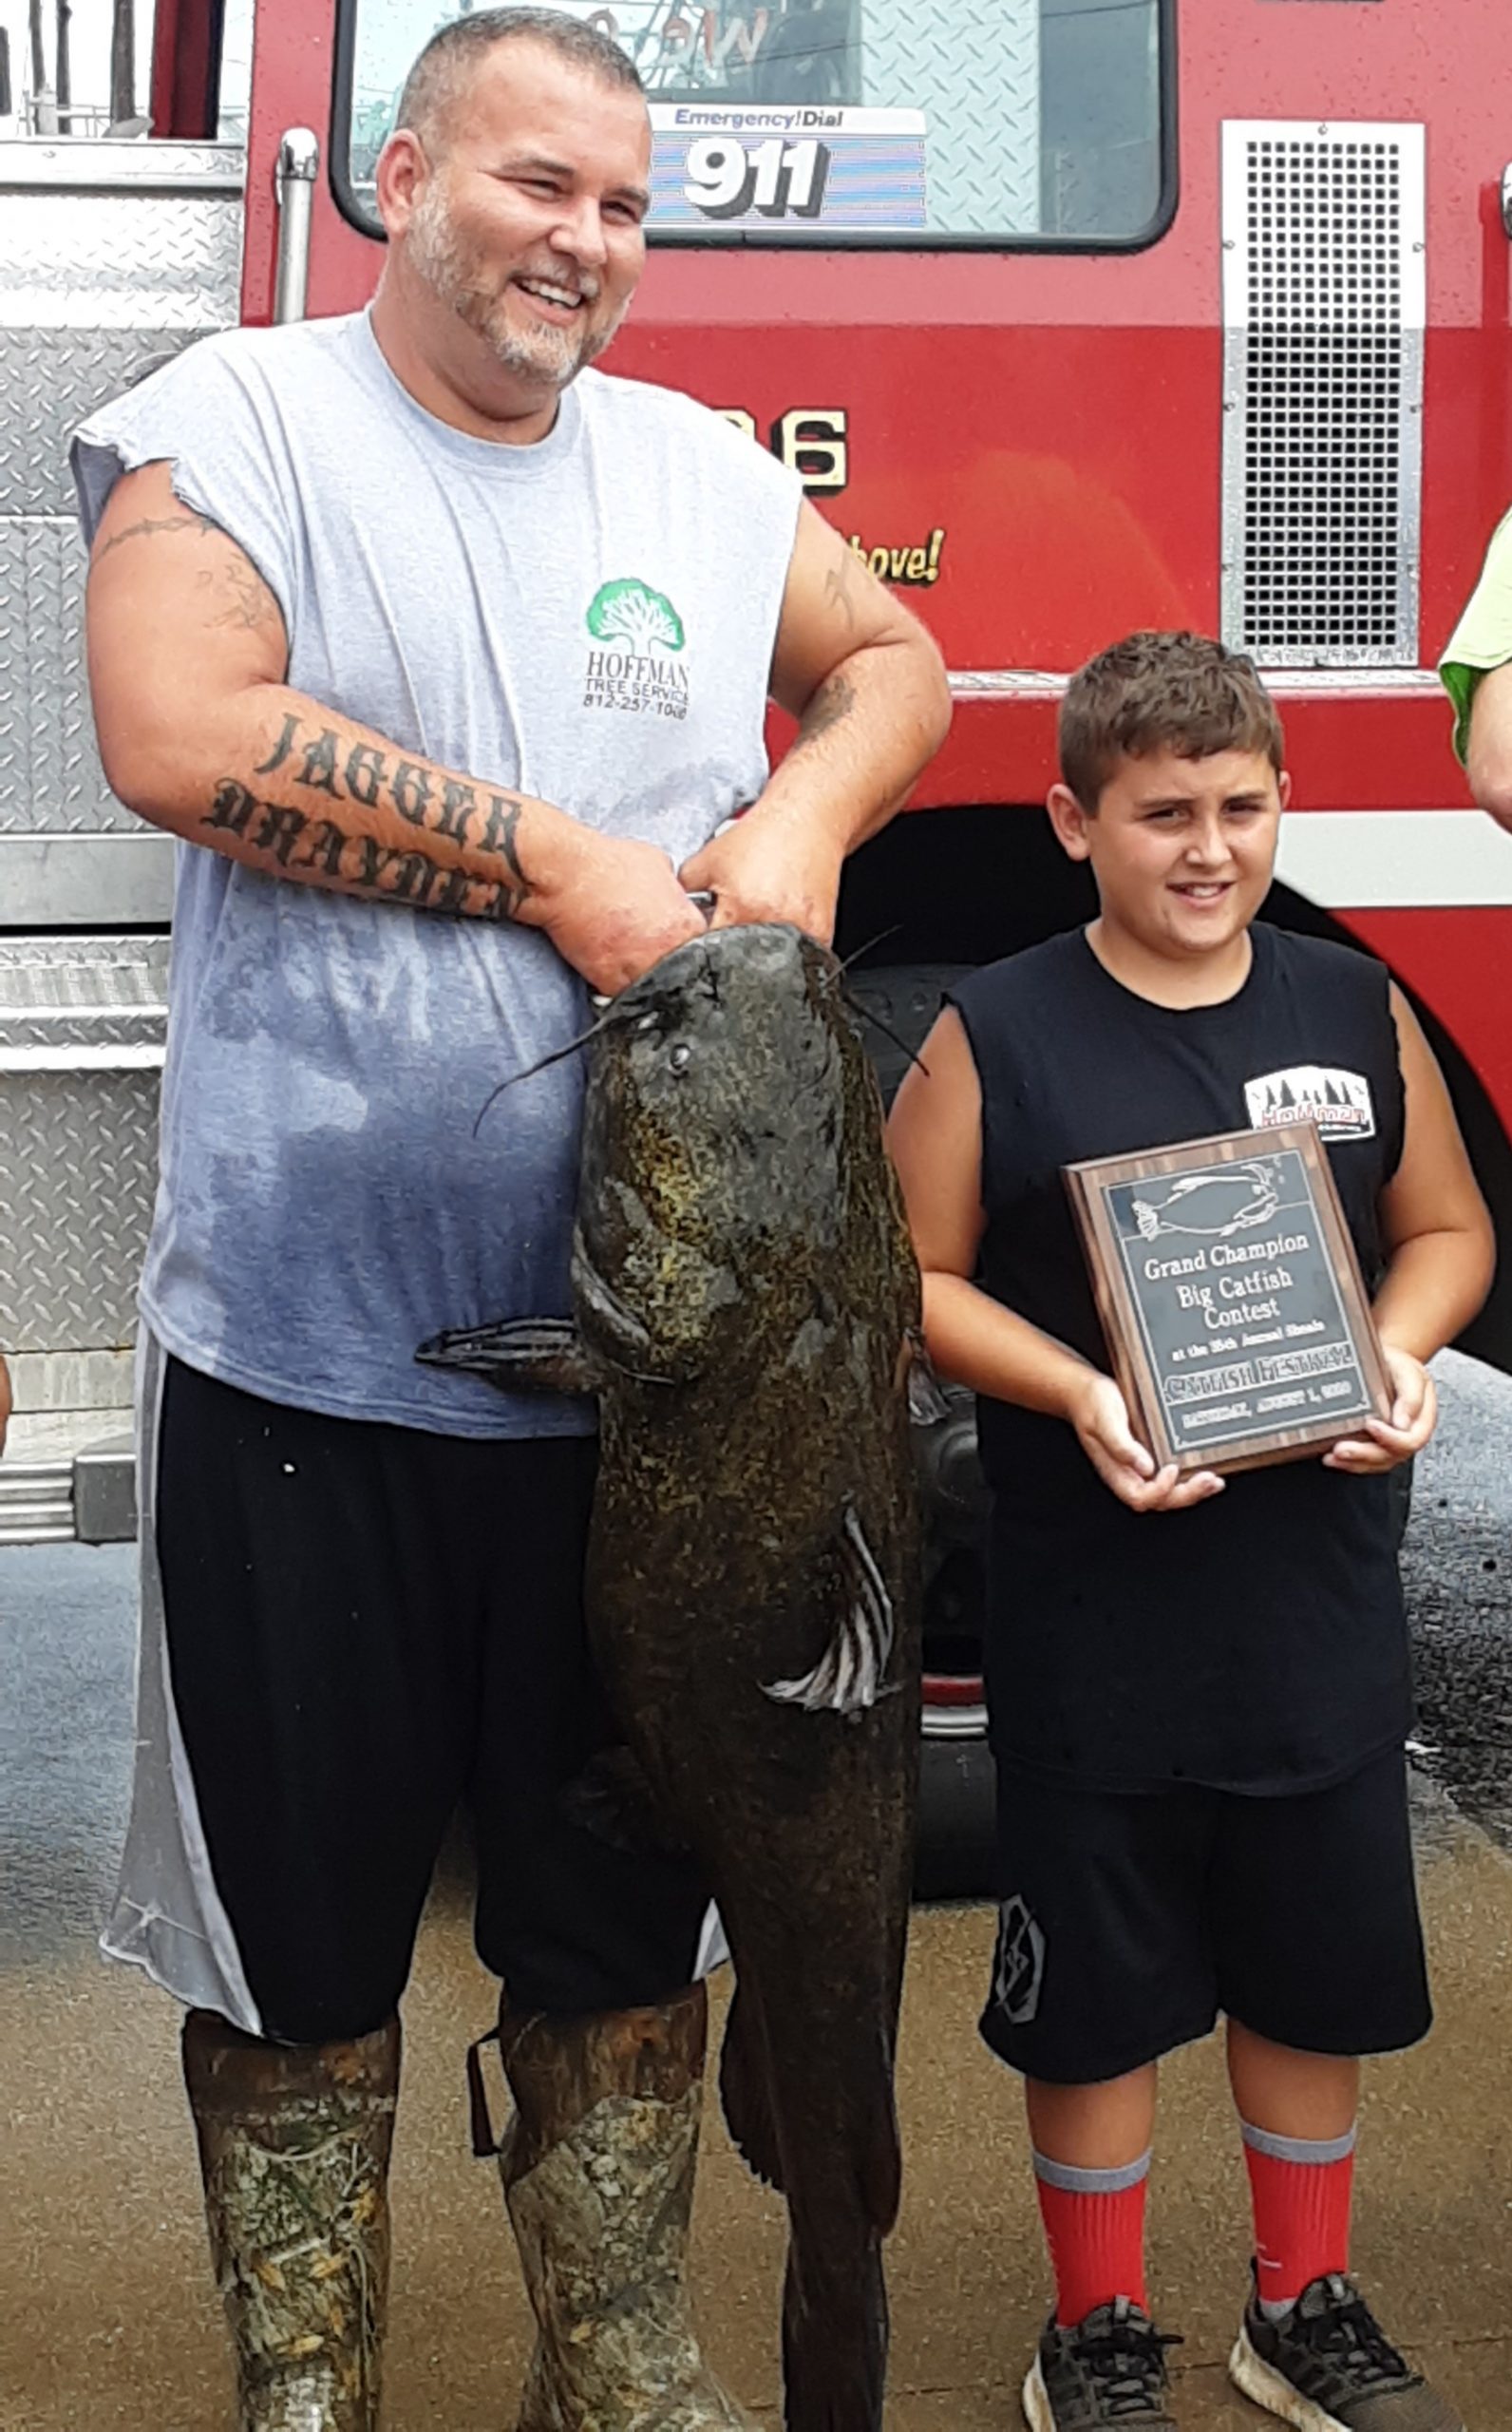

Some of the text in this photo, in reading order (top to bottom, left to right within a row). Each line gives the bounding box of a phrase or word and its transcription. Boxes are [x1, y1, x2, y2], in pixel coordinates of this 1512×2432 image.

[684, 137, 826, 217] 911
[712, 409, 846, 495] 6
[585, 678, 626, 694] TREE
[586, 651, 690, 688] HOFFMAN
[254, 712, 534, 893] JAGGER
[1144, 1233, 1310, 1280] Grand Champion
[1176, 1266, 1294, 1309] Big Catfish
[1204, 1298, 1281, 1329] Contest
[1172, 1349, 1186, 1362] at
[1187, 1344, 1209, 1358] the
